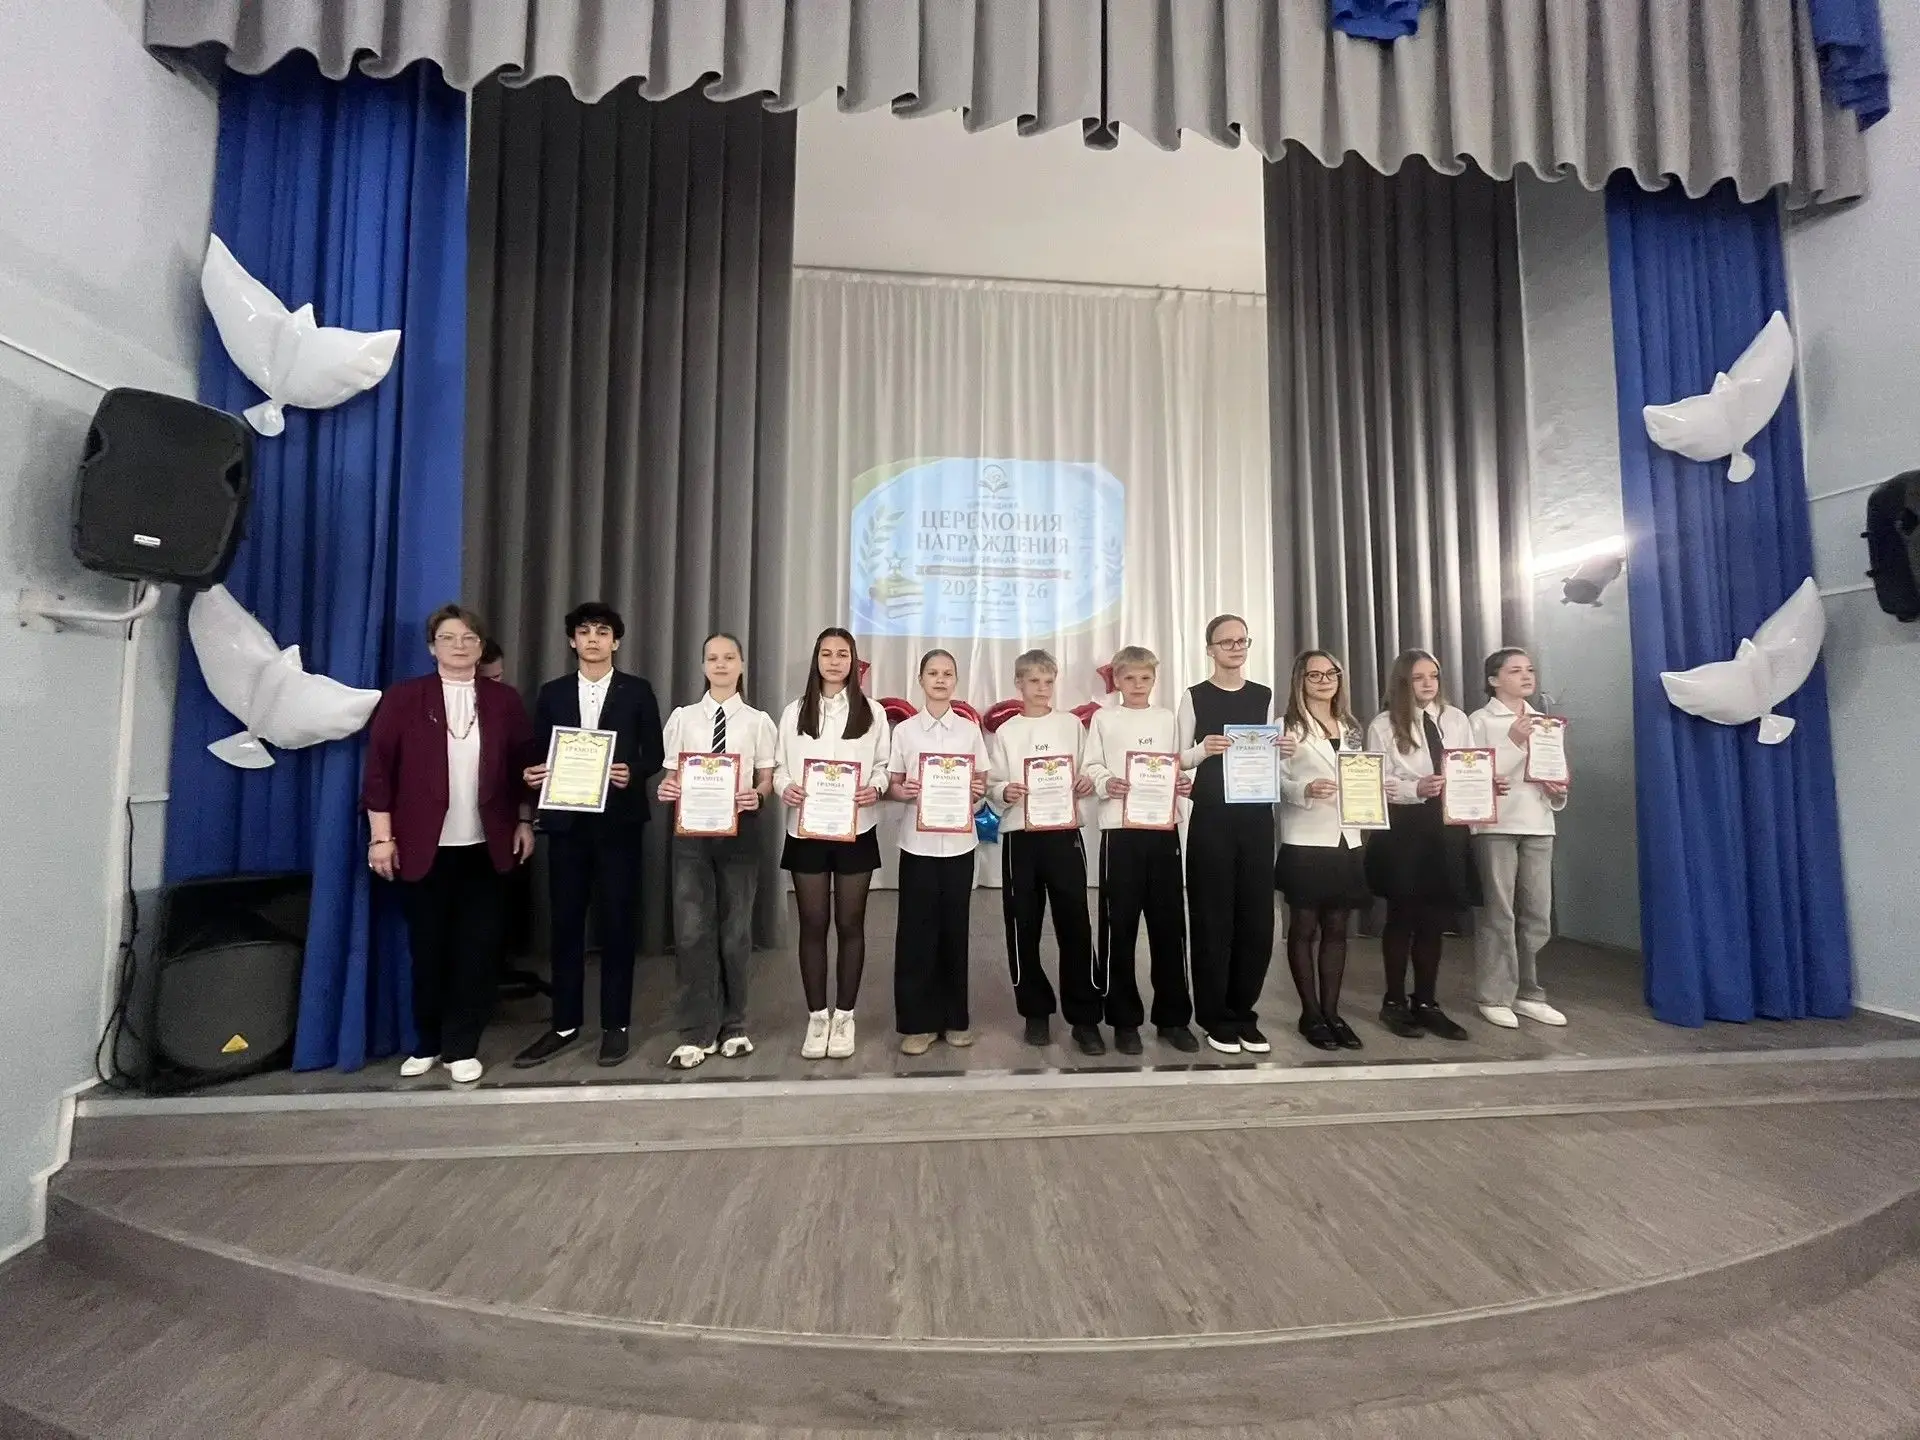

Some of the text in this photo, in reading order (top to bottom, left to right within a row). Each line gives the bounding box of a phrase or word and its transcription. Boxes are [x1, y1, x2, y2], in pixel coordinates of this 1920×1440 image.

[921, 510, 1063, 532] ЦЕРЕМОНИЯ
[917, 532, 1069, 554] НАГРАЖДЕНИЯ
[565, 746, 598, 754] ГРАМОТА
